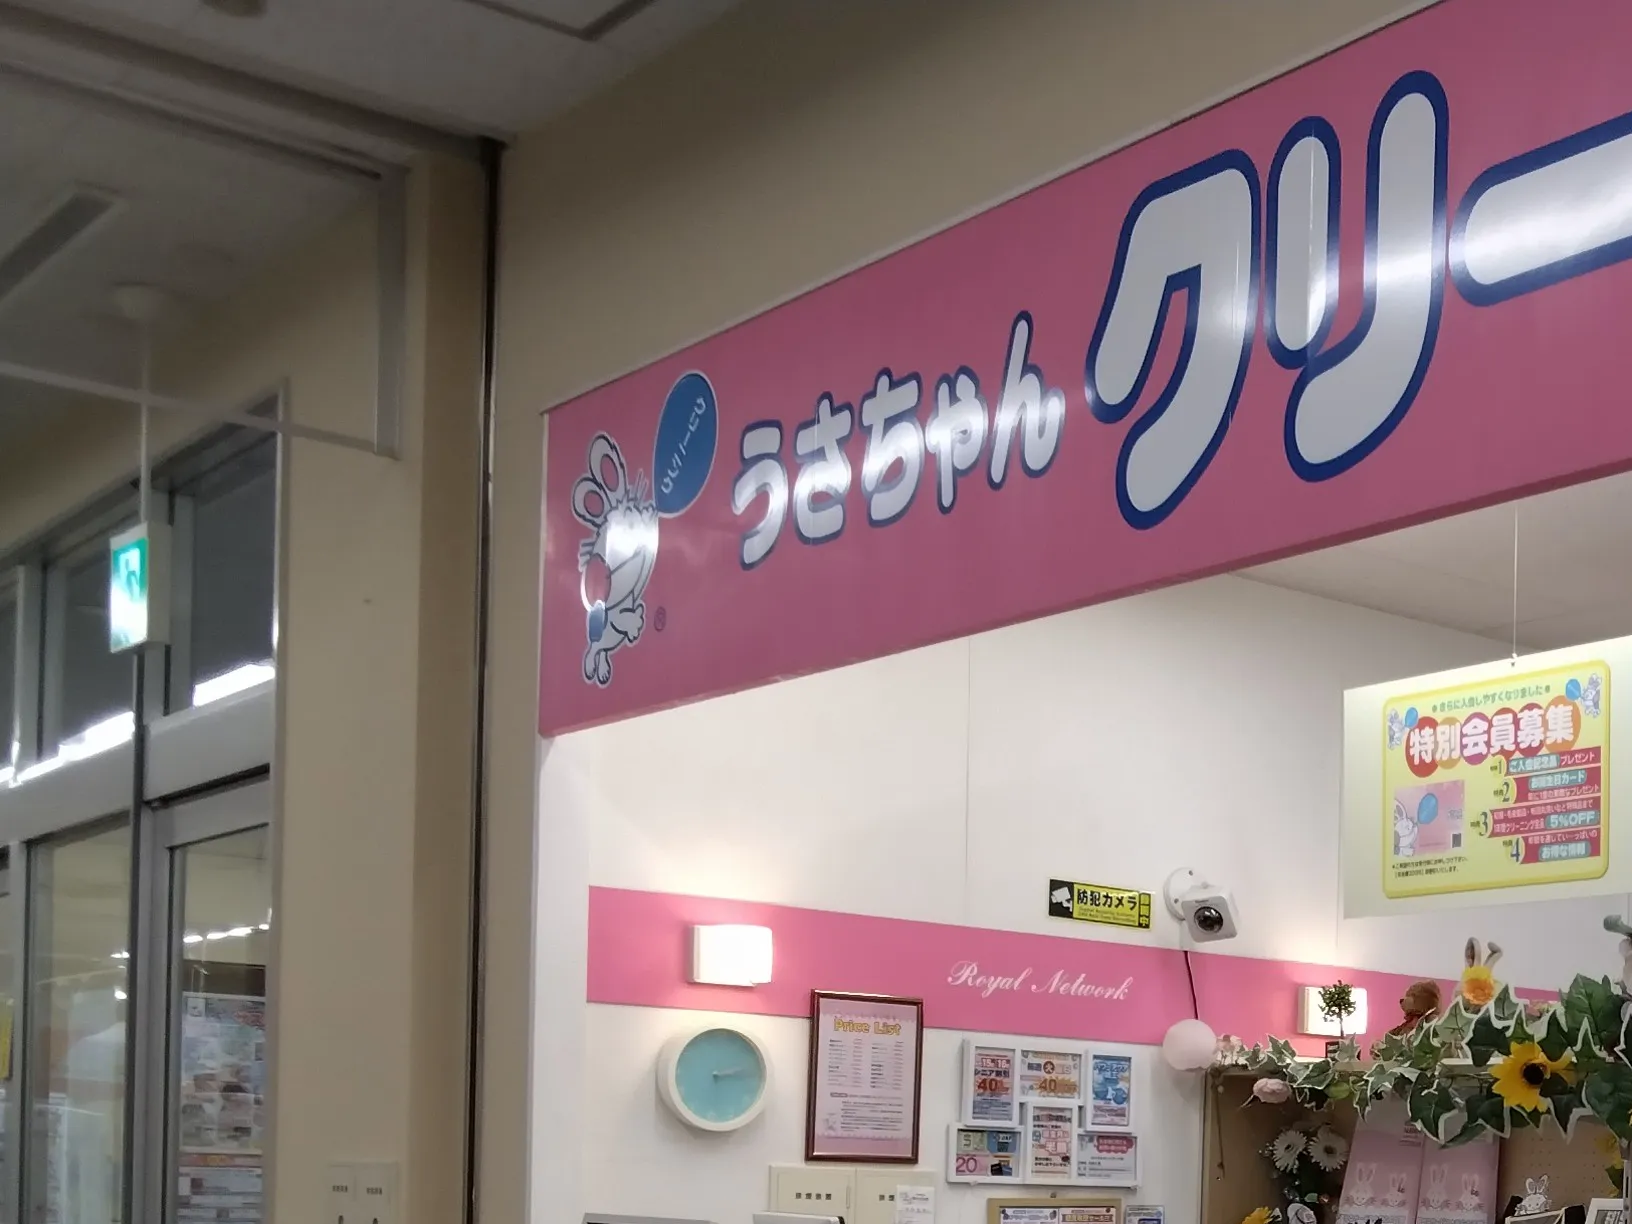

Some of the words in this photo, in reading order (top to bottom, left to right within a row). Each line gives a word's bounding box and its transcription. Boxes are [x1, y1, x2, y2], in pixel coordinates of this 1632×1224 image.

[731, 310, 1066, 571] うさちゃん
[1410, 704, 1575, 766] 特別会員募集
[1549, 811, 1596, 828] 5%OFF
[1077, 889, 1138, 911] 防犯カメラ
[947, 960, 1034, 999] Royal
[1031, 968, 1133, 1000] Network
[834, 1016, 870, 1034] Price
[873, 1021, 902, 1036] List
